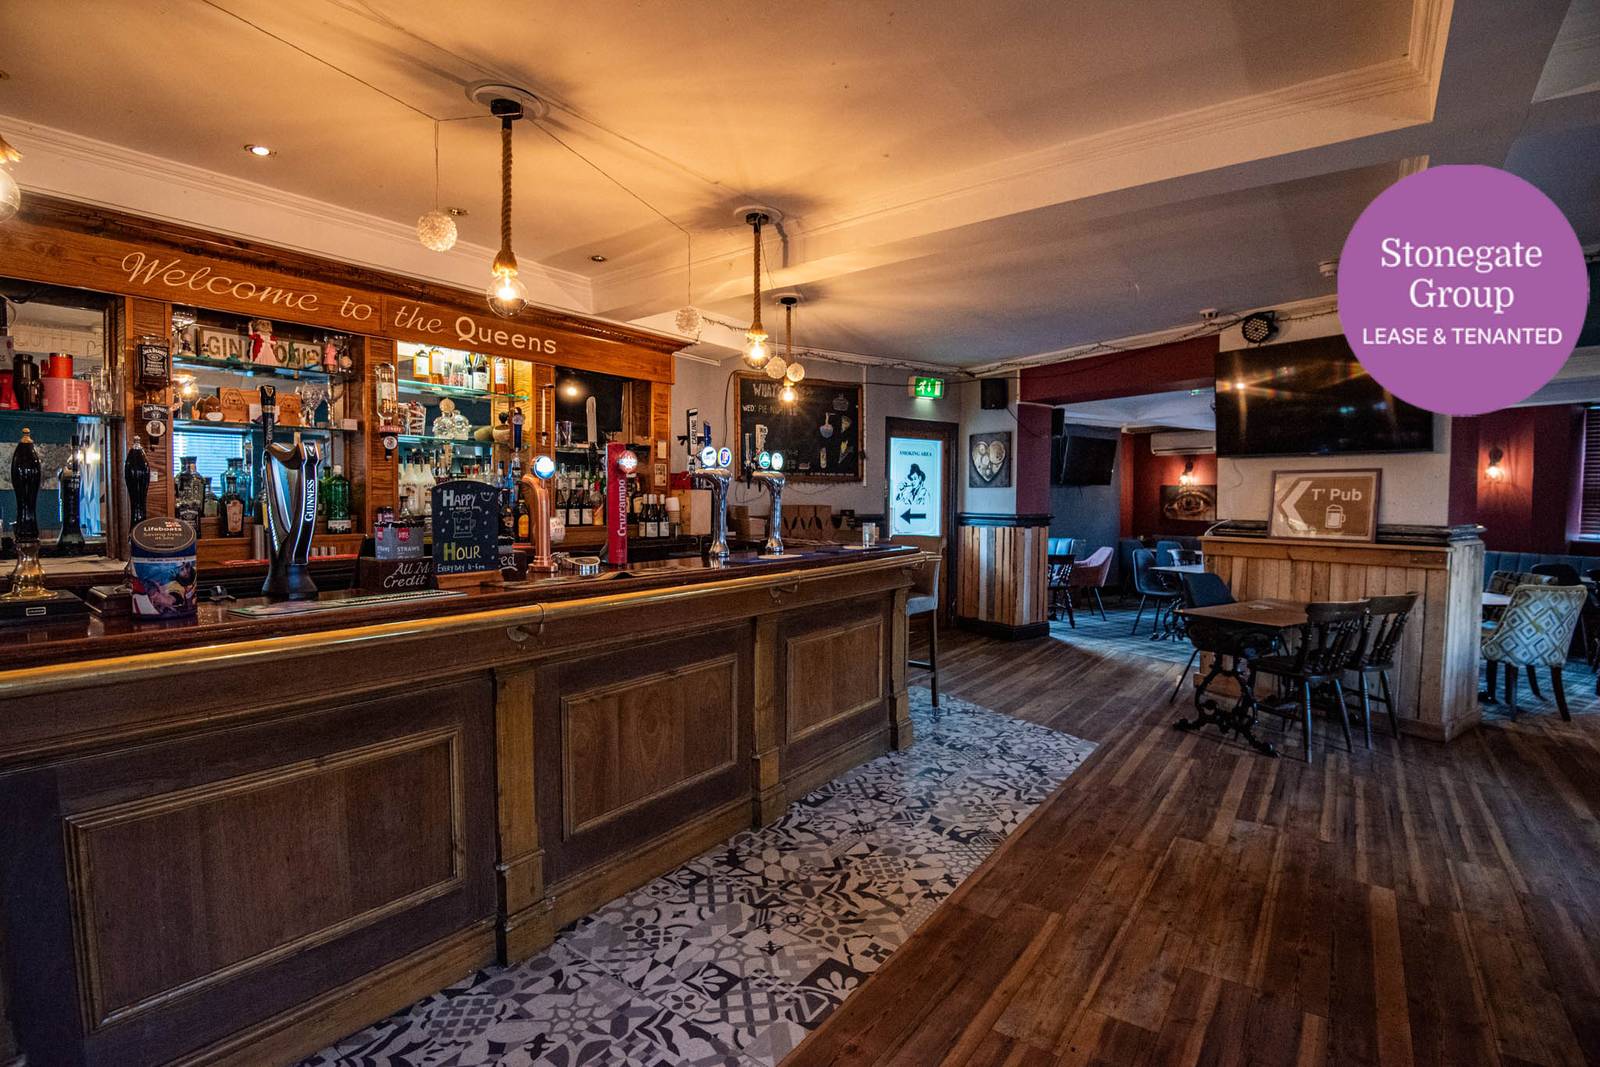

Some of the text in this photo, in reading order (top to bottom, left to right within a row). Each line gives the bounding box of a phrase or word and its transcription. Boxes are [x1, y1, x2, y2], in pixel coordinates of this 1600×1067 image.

[121, 252, 557, 355] Welcome to the Queens
[207, 335, 243, 358] GIN
[690, 419, 698, 445] CARLING
[304, 479, 315, 522] GUINNESS
[1311, 488, 1363, 501] T' Pub
[617, 479, 627, 537] Cruzcampo
[443, 542, 482, 562] HOUR
[392, 561, 413, 577] All
[499, 554, 517, 567] ed
[383, 575, 428, 589] Credit
